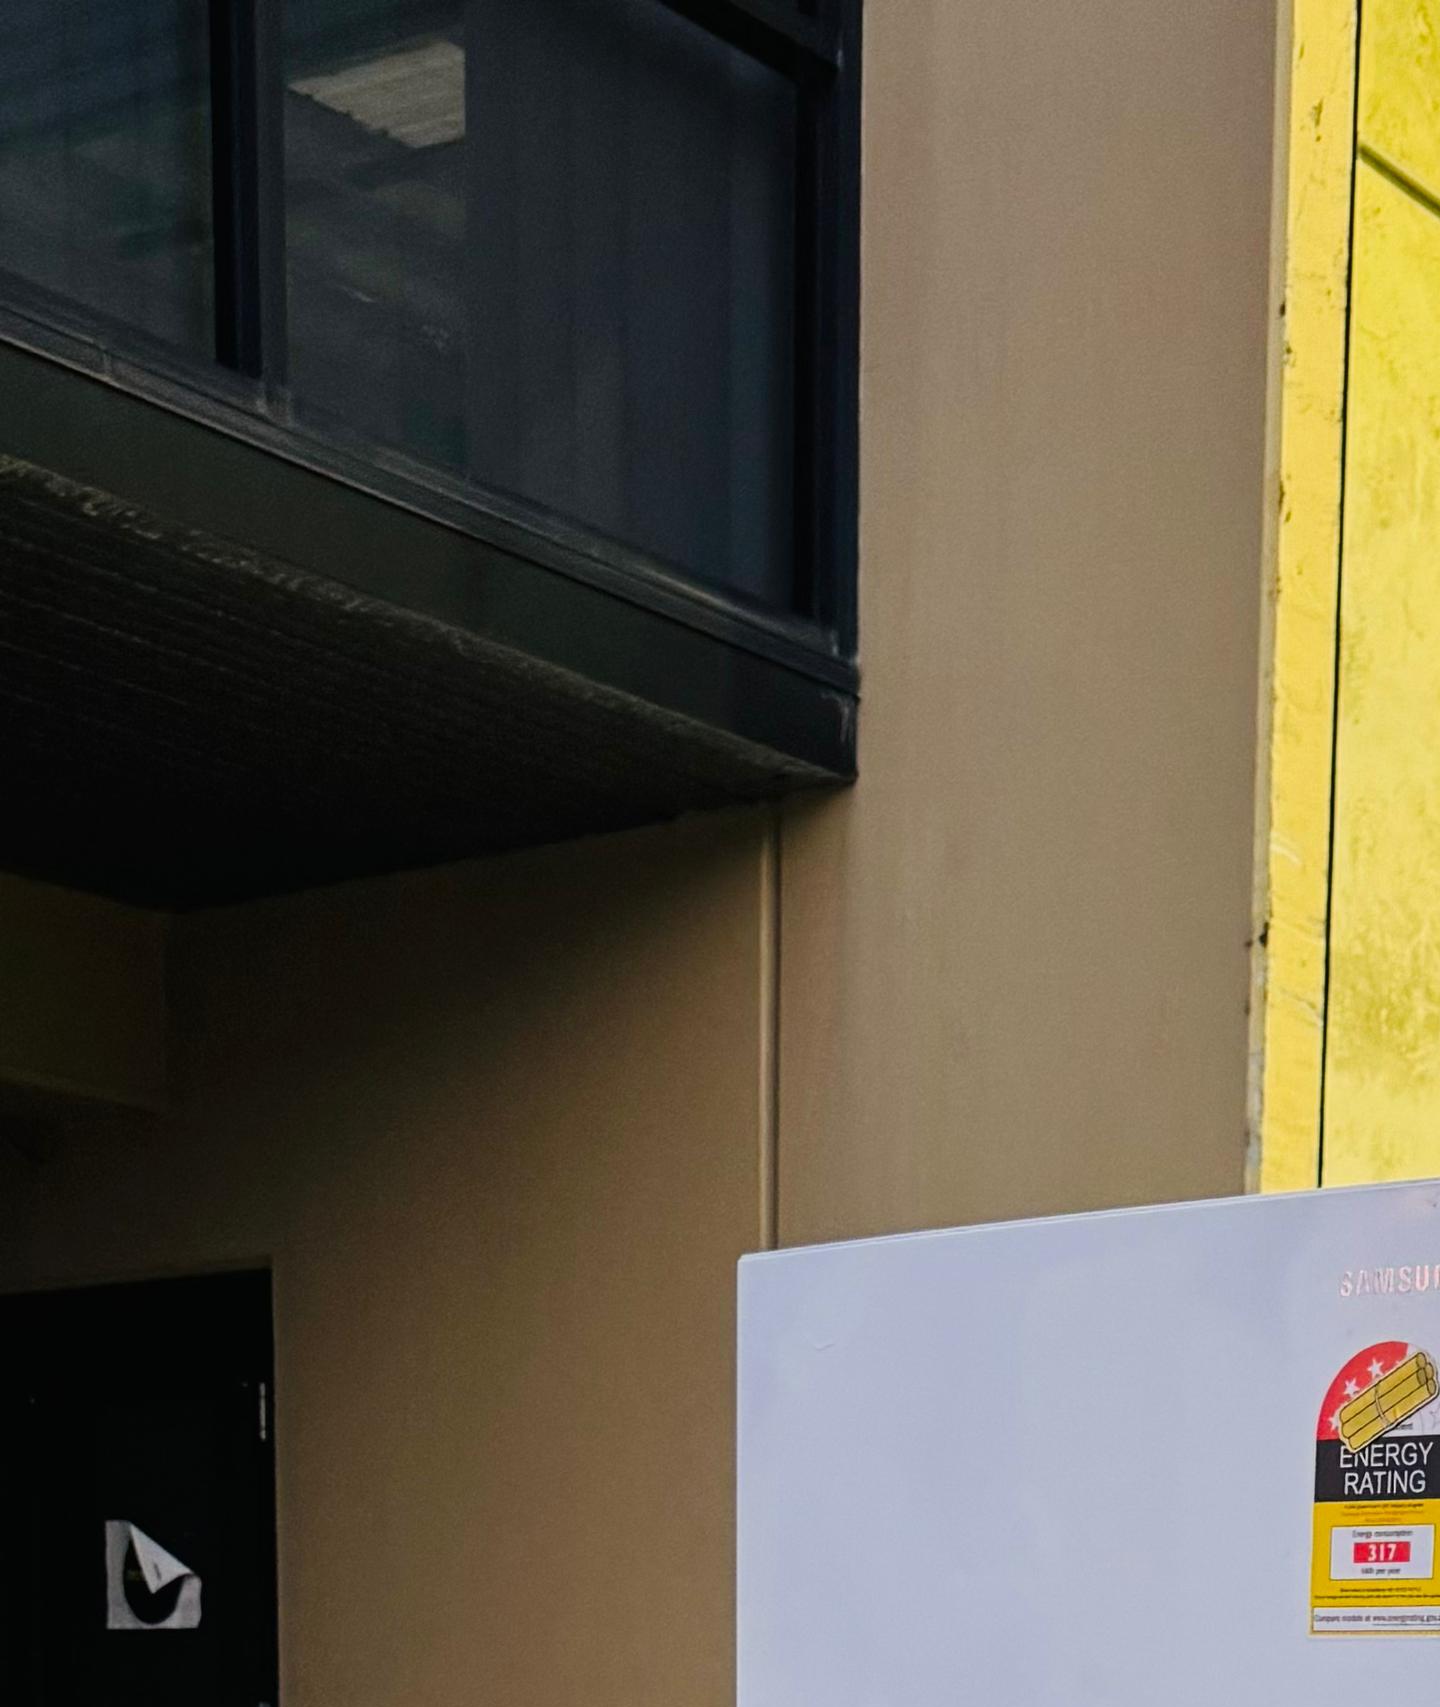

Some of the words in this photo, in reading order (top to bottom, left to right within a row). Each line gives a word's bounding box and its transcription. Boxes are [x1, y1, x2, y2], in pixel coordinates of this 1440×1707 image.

[1339, 1441, 1434, 1468] ENERGY
[1343, 1469, 1426, 1495] RATING
[1367, 1543, 1397, 1562] 317
